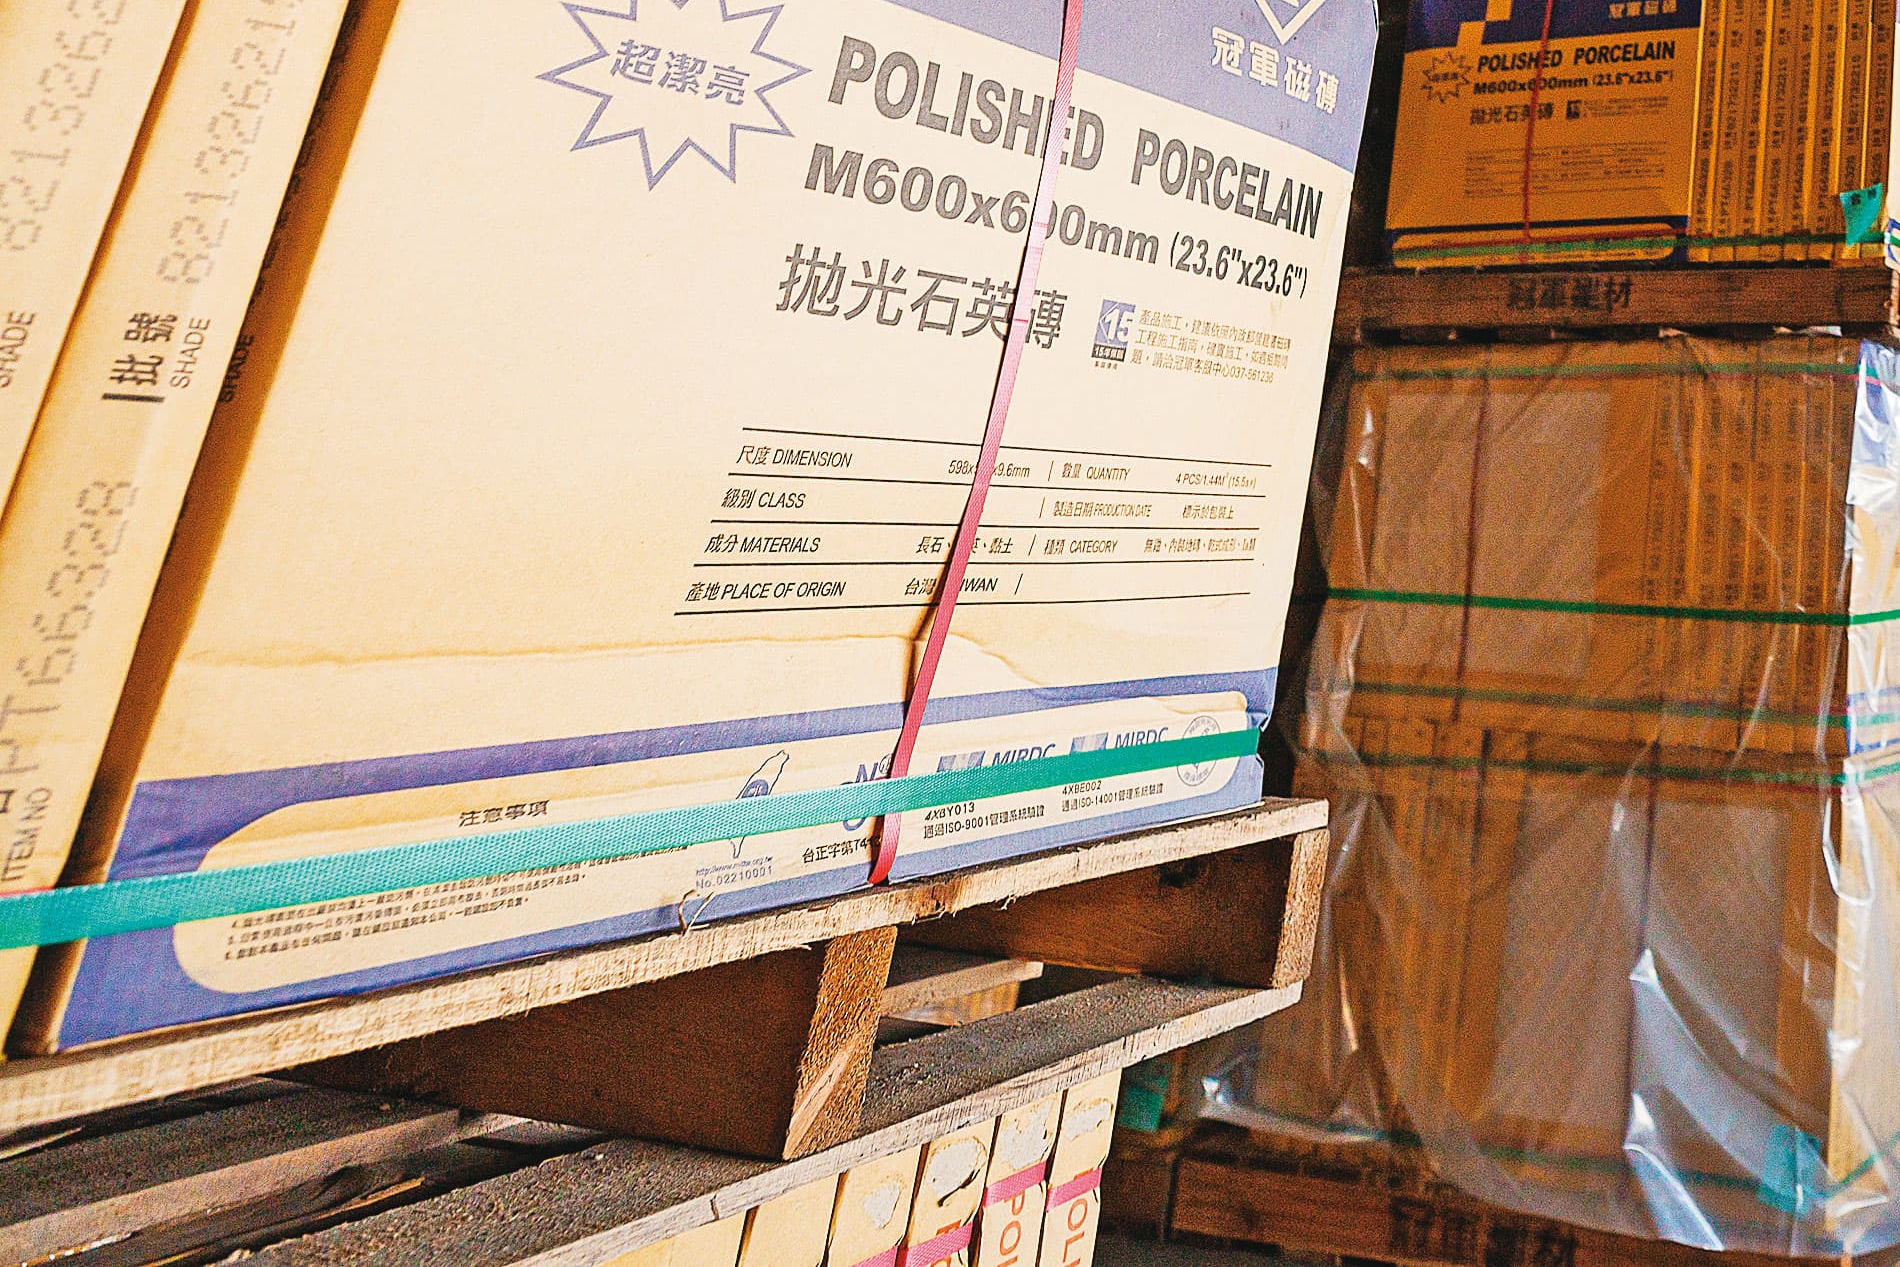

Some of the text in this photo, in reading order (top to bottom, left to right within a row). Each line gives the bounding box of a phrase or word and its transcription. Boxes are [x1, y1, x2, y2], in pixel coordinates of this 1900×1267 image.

[610, 37, 749, 107] 超潔亮
[1210, 26, 1342, 115] 冠軍磁磚
[1476, 40, 1676, 74] POLISHED PORCELAIN
[1129, 129, 1324, 240] PORCELAIN
[108, 311, 179, 388] 批號
[168, 317, 212, 389] SHADE
[736, 445, 1032, 479] 尺度 DIMENSION 598xx9.6mm
[1086, 466, 1131, 482] QUANTITY
[721, 488, 807, 509] 級別 CLASS
[704, 533, 739, 554] 成分
[740, 536, 822, 553] MATERIALS
[1069, 539, 1119, 555] CATEGORY
[685, 581, 721, 602] 產地
[721, 582, 771, 600] PLACE
[773, 582, 796, 598] OF
[796, 581, 847, 598] ORIGIN
[458, 800, 551, 829] 注意事項
[0, 786, 54, 883] ITEM NO
